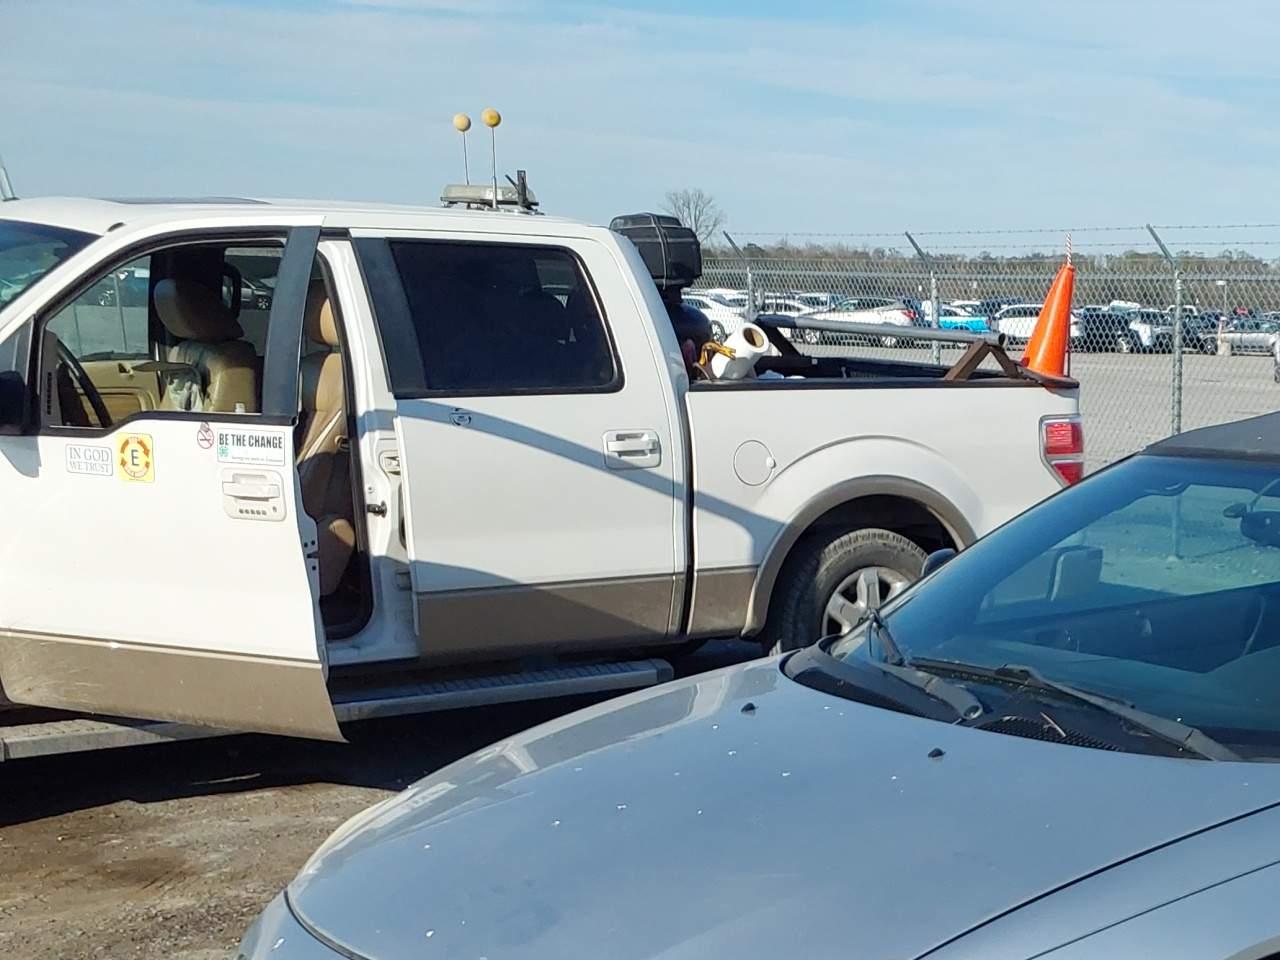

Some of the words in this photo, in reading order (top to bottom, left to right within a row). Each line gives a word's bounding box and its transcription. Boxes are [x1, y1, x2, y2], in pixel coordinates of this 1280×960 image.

[219, 433, 229, 446] BE
[231, 434, 246, 447] THE
[248, 435, 282, 449] CHANGE
[69, 447, 81, 460] IN
[84, 448, 109, 462] GOD
[131, 449, 139, 466] E
[70, 460, 83, 471] WE
[84, 461, 109, 473] TRUST
